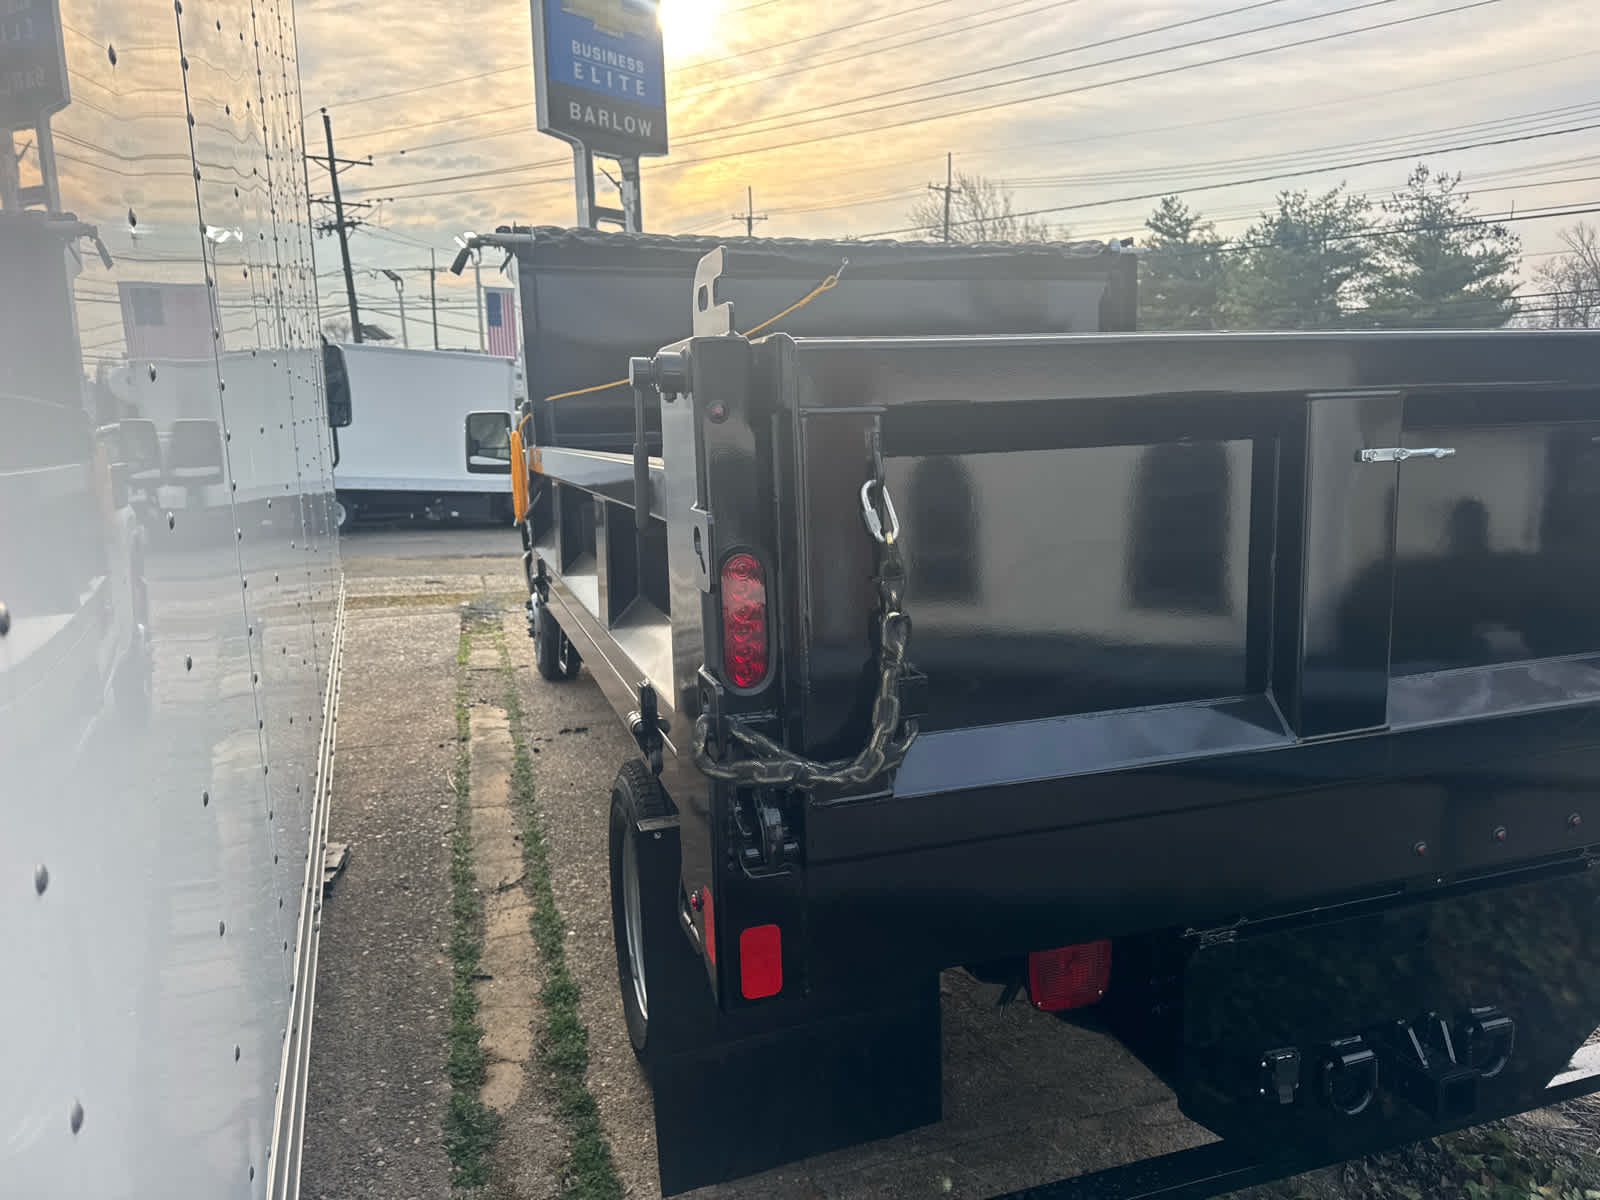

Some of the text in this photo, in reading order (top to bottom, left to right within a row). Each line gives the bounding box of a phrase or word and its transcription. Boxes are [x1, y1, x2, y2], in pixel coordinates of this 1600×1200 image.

[572, 39, 644, 73] BUSINESS
[573, 62, 645, 96] ELITE
[569, 102, 652, 137] BARLOW
